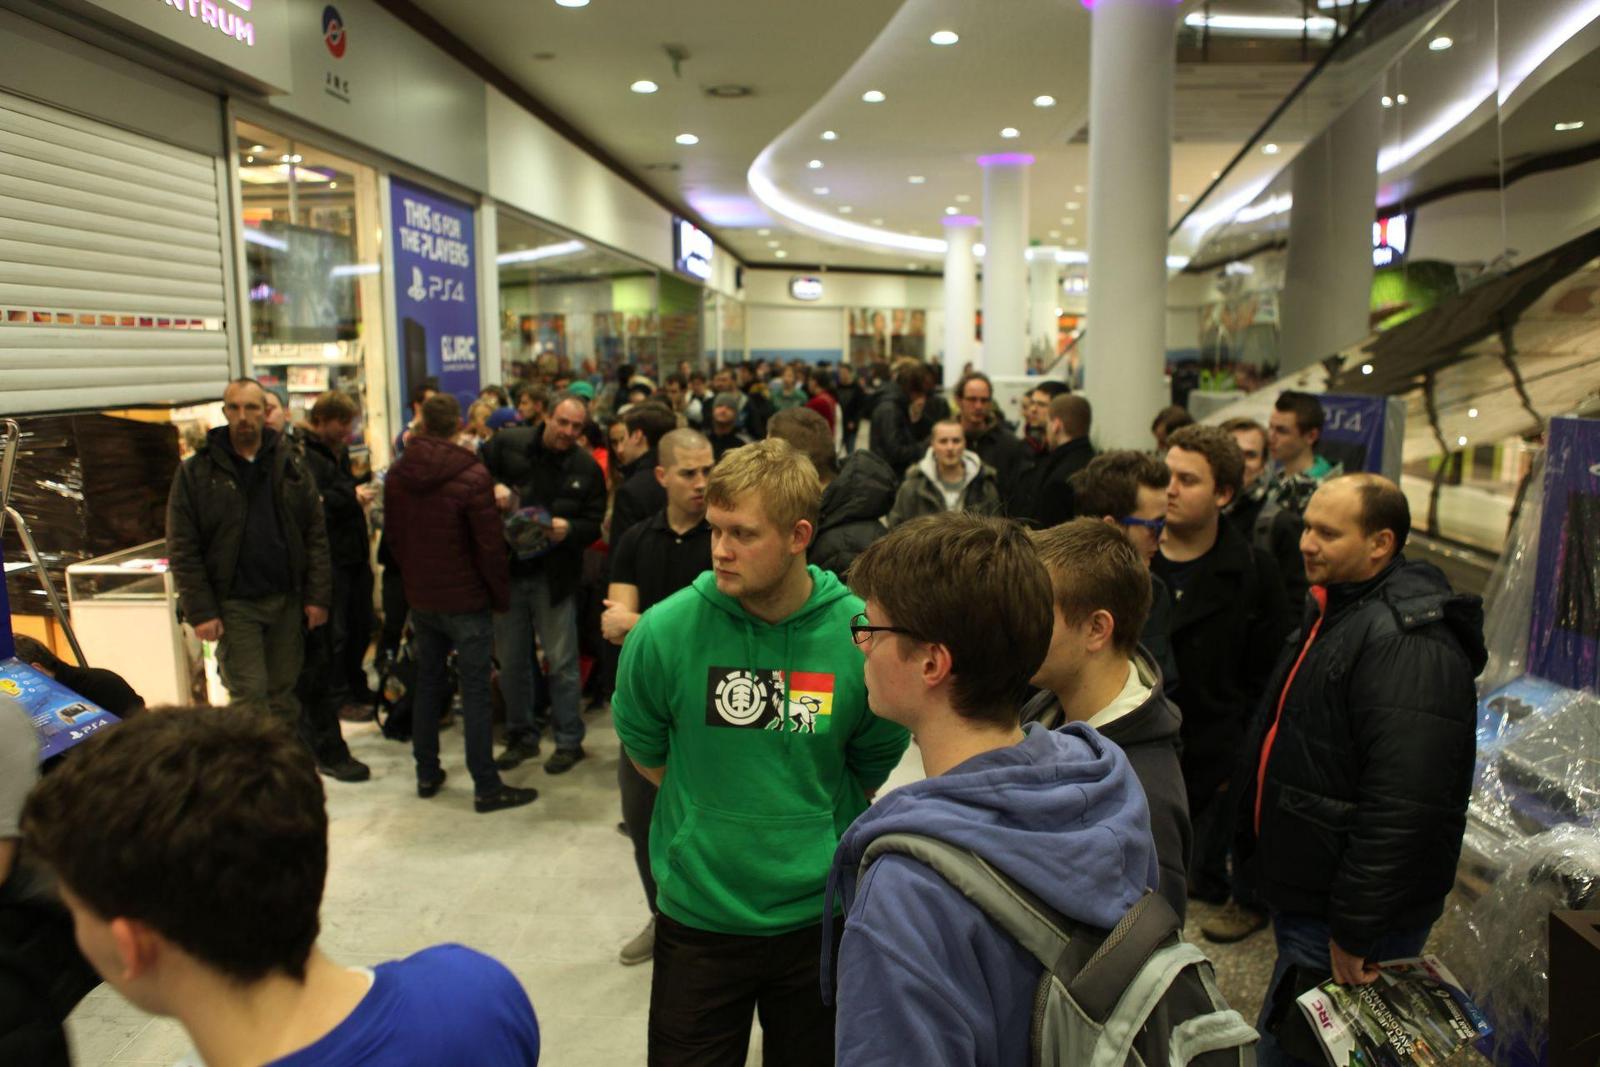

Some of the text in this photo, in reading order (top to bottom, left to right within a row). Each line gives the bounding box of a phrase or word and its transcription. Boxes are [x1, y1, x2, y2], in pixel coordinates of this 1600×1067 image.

[403, 199, 461, 239] THIS IS FOR
[399, 226, 469, 268] THE PLAYERS
[427, 275, 464, 302] PS4
[81, 719, 108, 734] PS4
[1311, 999, 1333, 1029] JRC
